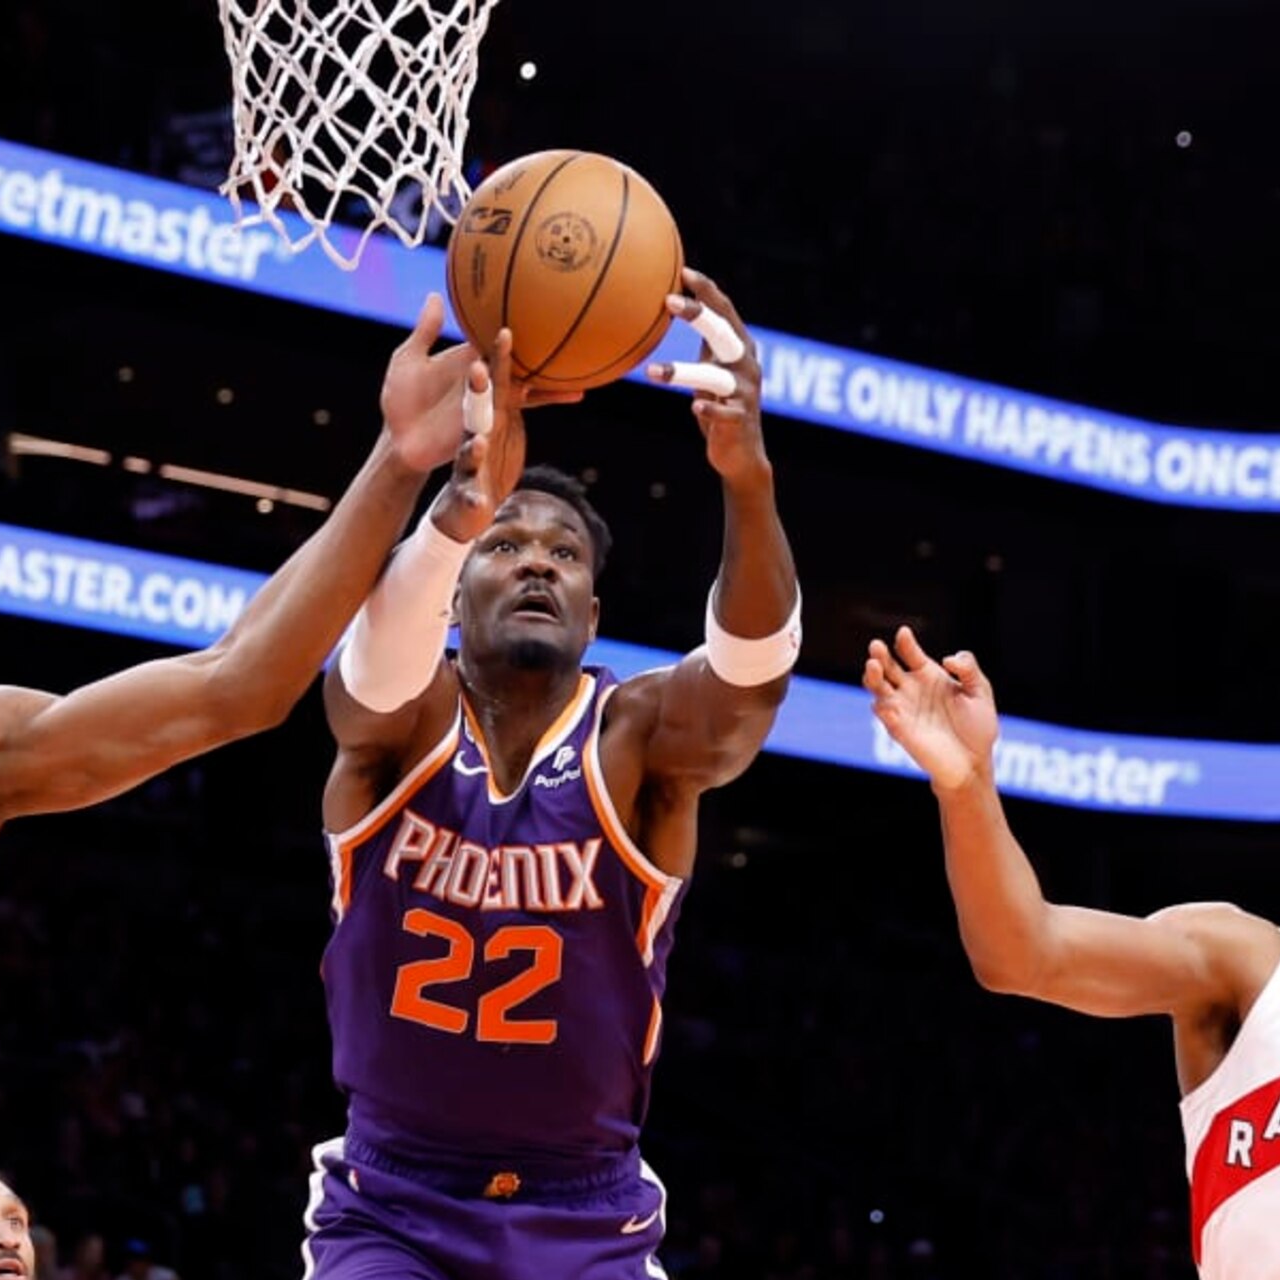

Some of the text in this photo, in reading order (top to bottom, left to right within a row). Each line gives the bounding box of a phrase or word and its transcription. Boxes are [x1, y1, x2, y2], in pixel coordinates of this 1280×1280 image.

[846, 366, 961, 440] ONLY
[964, 391, 1151, 485] HAPPENS
[383, 807, 605, 912] PHOENIX
[390, 907, 564, 1044] 22
